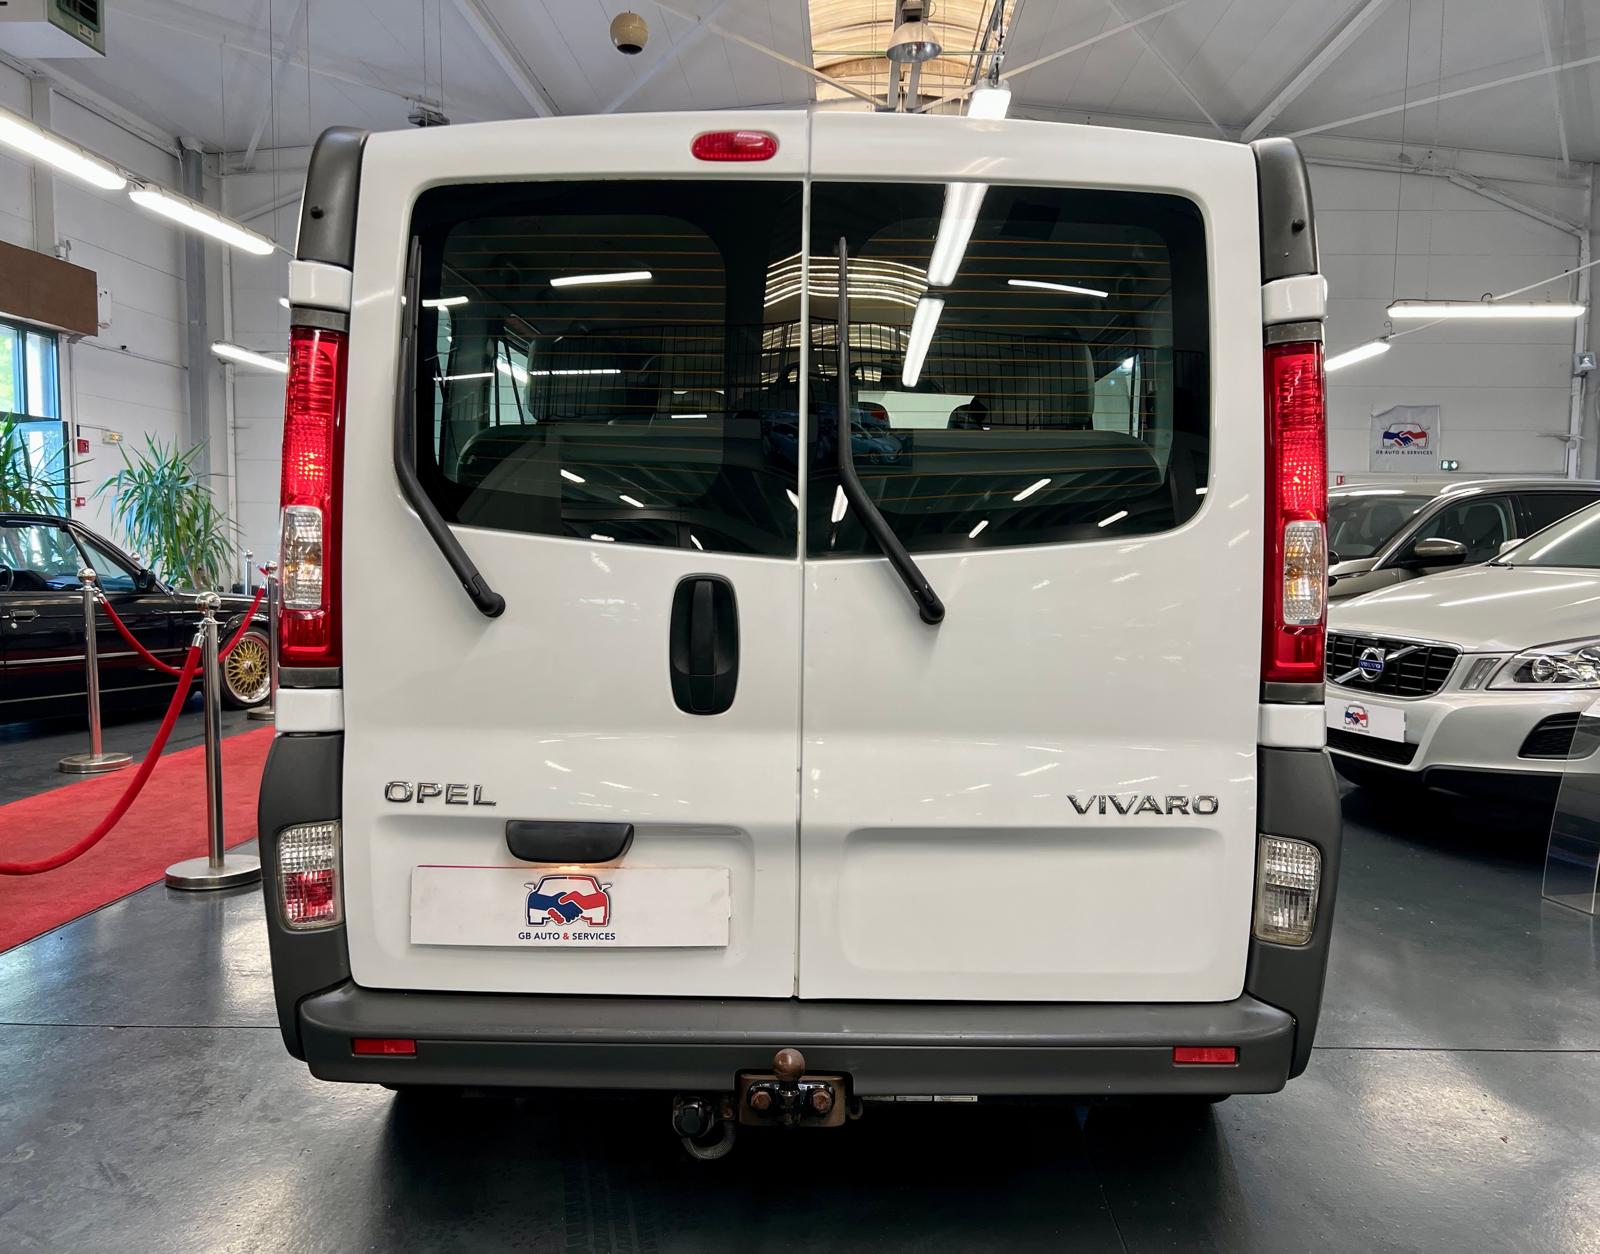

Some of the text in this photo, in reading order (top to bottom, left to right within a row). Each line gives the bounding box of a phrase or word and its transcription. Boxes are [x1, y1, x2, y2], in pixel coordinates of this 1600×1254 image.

[384, 781, 497, 806] OPEL
[1066, 794, 1219, 815] VIVARO
[518, 931, 616, 941] GB AUTO & SERVICES
